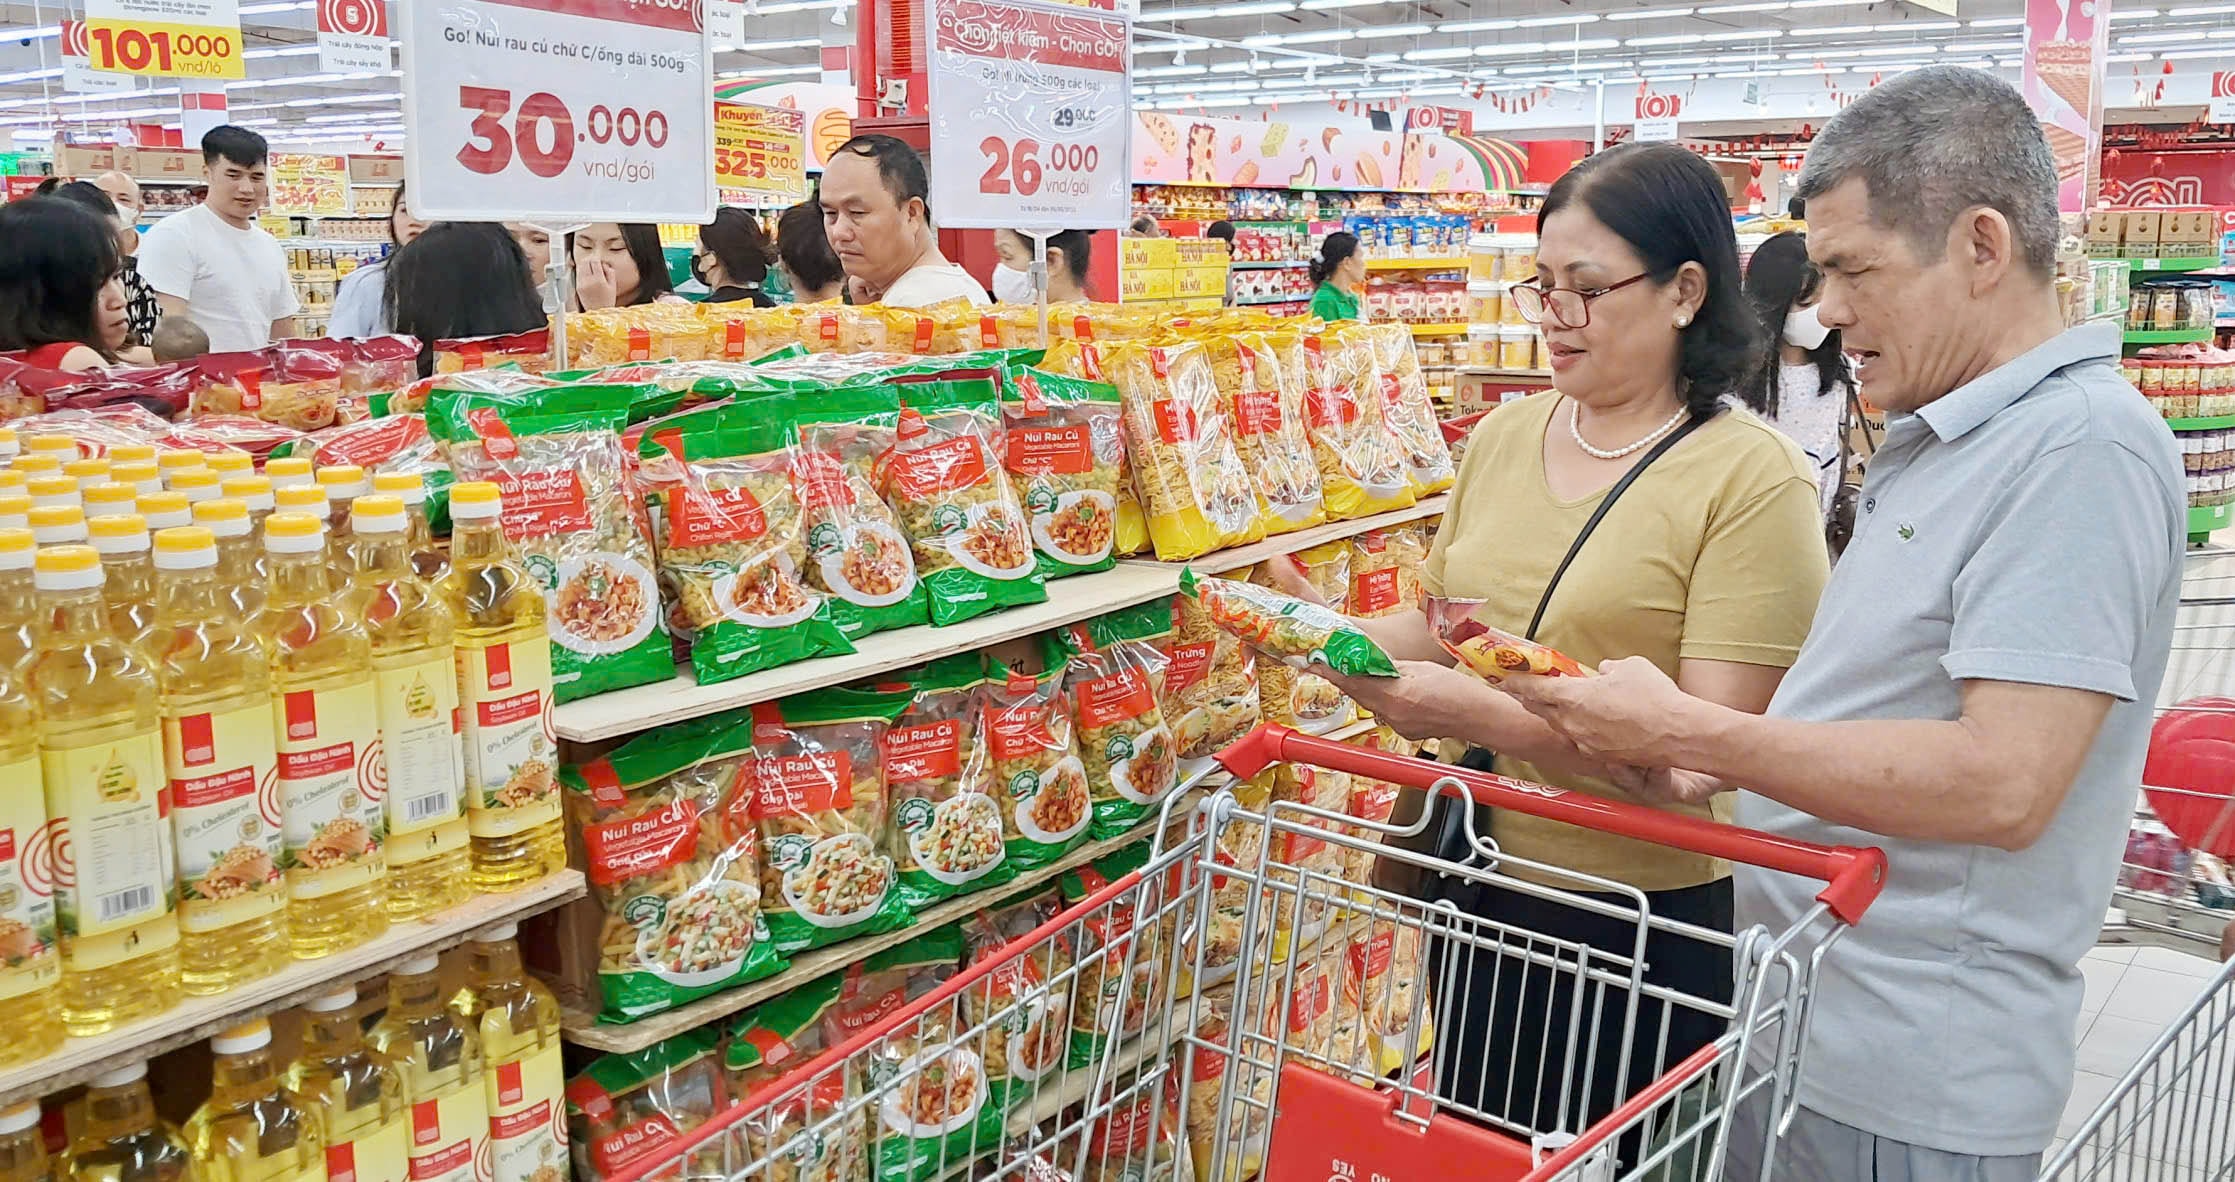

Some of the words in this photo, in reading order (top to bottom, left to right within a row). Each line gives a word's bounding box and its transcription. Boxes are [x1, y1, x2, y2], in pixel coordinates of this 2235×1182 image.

[92, 28, 231, 71] 101.000
[444, 27, 471, 44] Go!
[505, 36, 528, 52] rau
[532, 39, 548, 54] củ
[553, 42, 577, 57] chữ
[581, 45, 624, 66] C/ống
[627, 50, 648, 67] dài
[650, 54, 685, 73] 500g
[1060, 35, 1092, 58] Chọn
[1095, 38, 1119, 58] GO!
[456, 85, 669, 178] 30.000
[583, 158, 656, 183] vnd/gói
[980, 136, 1099, 196] 26.000
[1044, 431, 1063, 441] Rau
[1174, 648, 1206, 660] Trứng
[911, 729, 934, 741] Rau
[937, 722, 952, 736] Củ
[786, 761, 814, 773] Rau
[632, 817, 659, 834] Rau
[1331, 1158, 1356, 1178] YES
